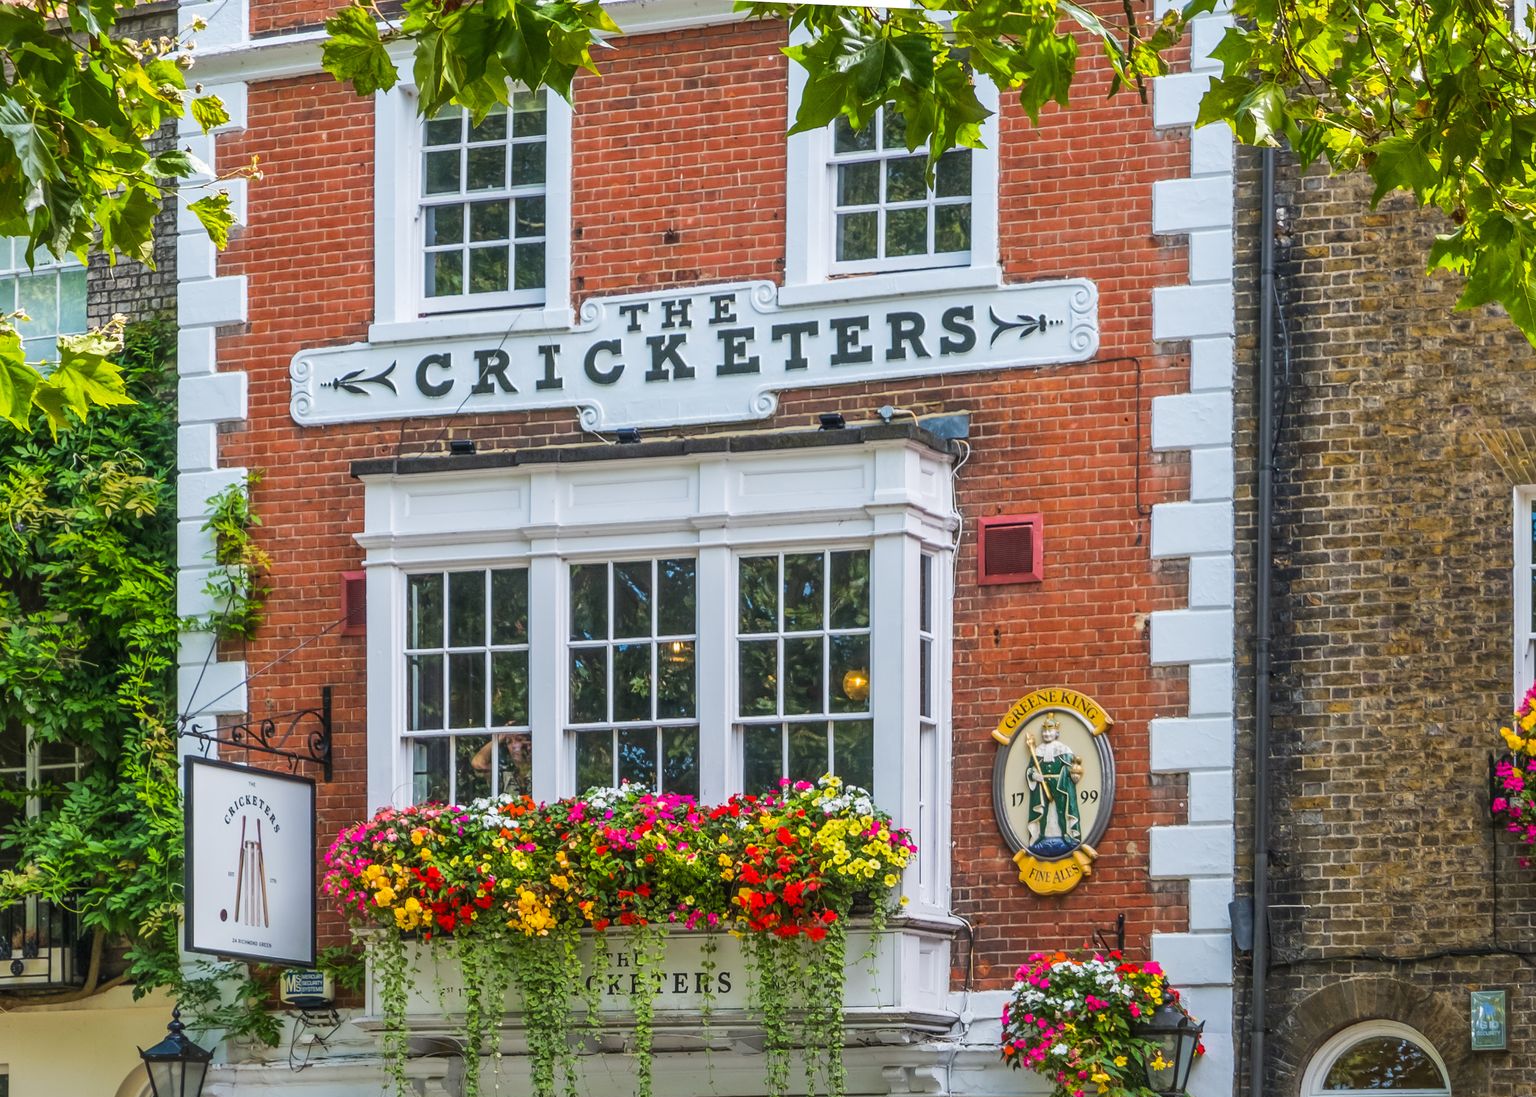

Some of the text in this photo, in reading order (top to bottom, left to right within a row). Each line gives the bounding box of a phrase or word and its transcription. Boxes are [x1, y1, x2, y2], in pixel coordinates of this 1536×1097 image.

[619, 294, 738, 332] THE
[415, 305, 976, 398] CRICKETERS
[1005, 690, 1098, 729] GREENE KING
[224, 795, 281, 834] CRICKETERS
[1029, 864, 1080, 884] FINE ALES
